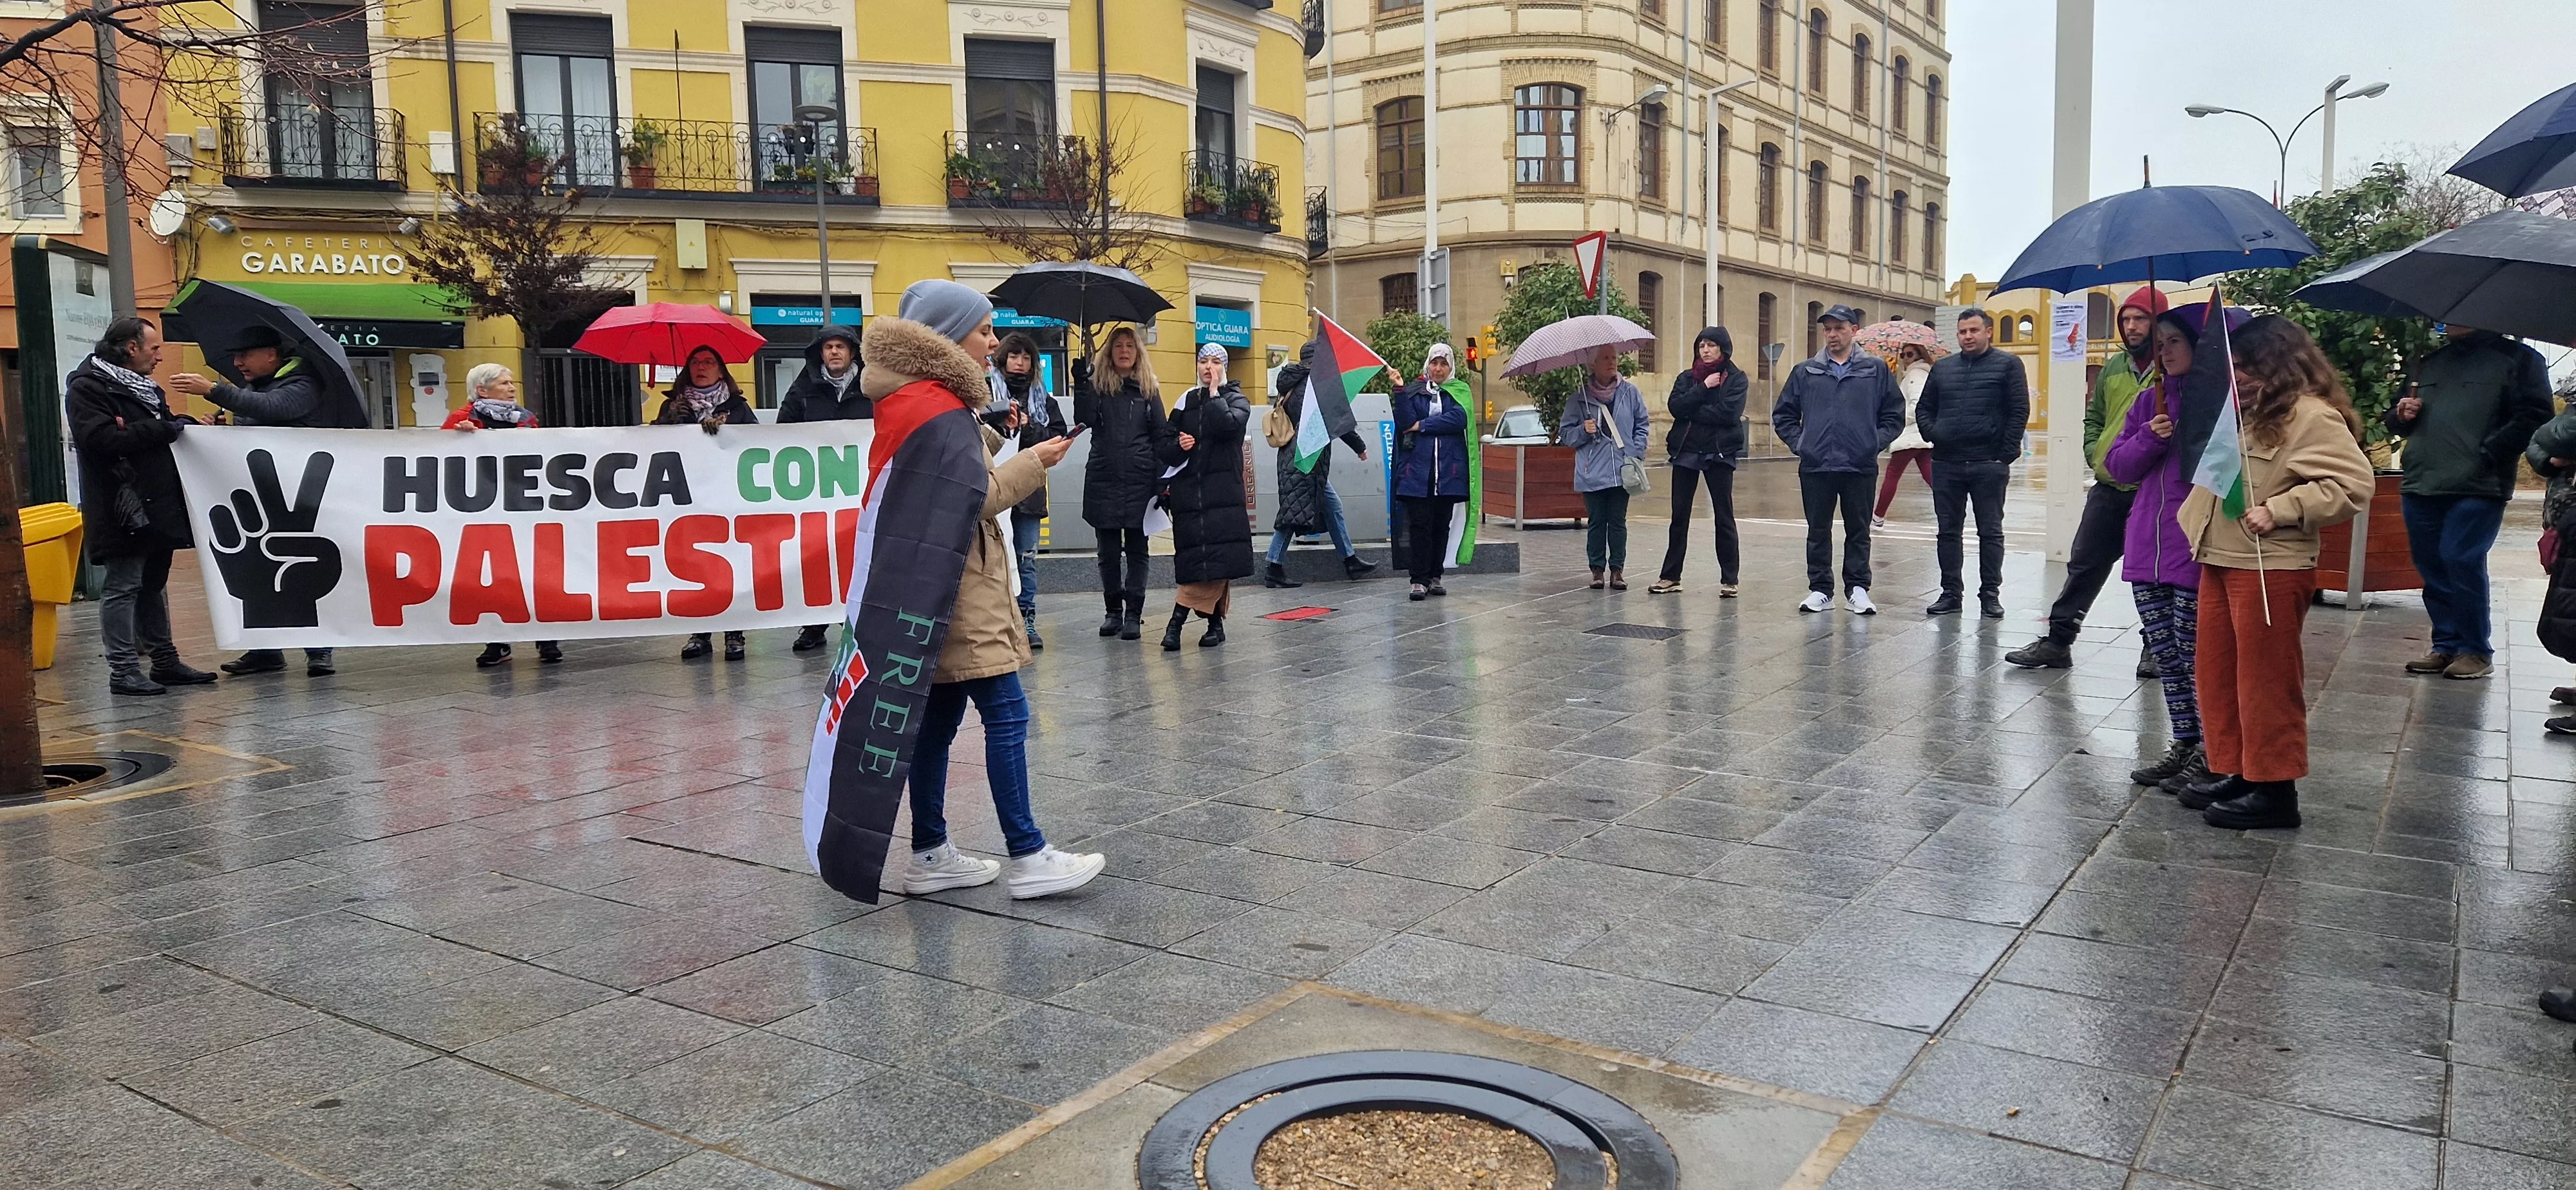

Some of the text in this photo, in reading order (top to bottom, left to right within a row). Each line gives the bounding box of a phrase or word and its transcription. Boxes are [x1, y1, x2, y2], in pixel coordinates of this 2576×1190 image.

[241, 236, 402, 249] CAFETERIA
[242, 252, 404, 274] GARABATO
[1196, 319, 1249, 335] ÓPTICA GUARA
[1206, 334, 1240, 343] AUDIOLOGÍA
[383, 445, 858, 513] HUESCA CON
[1244, 440, 1255, 505] ORGANIC
[858, 607, 936, 779] FREE
